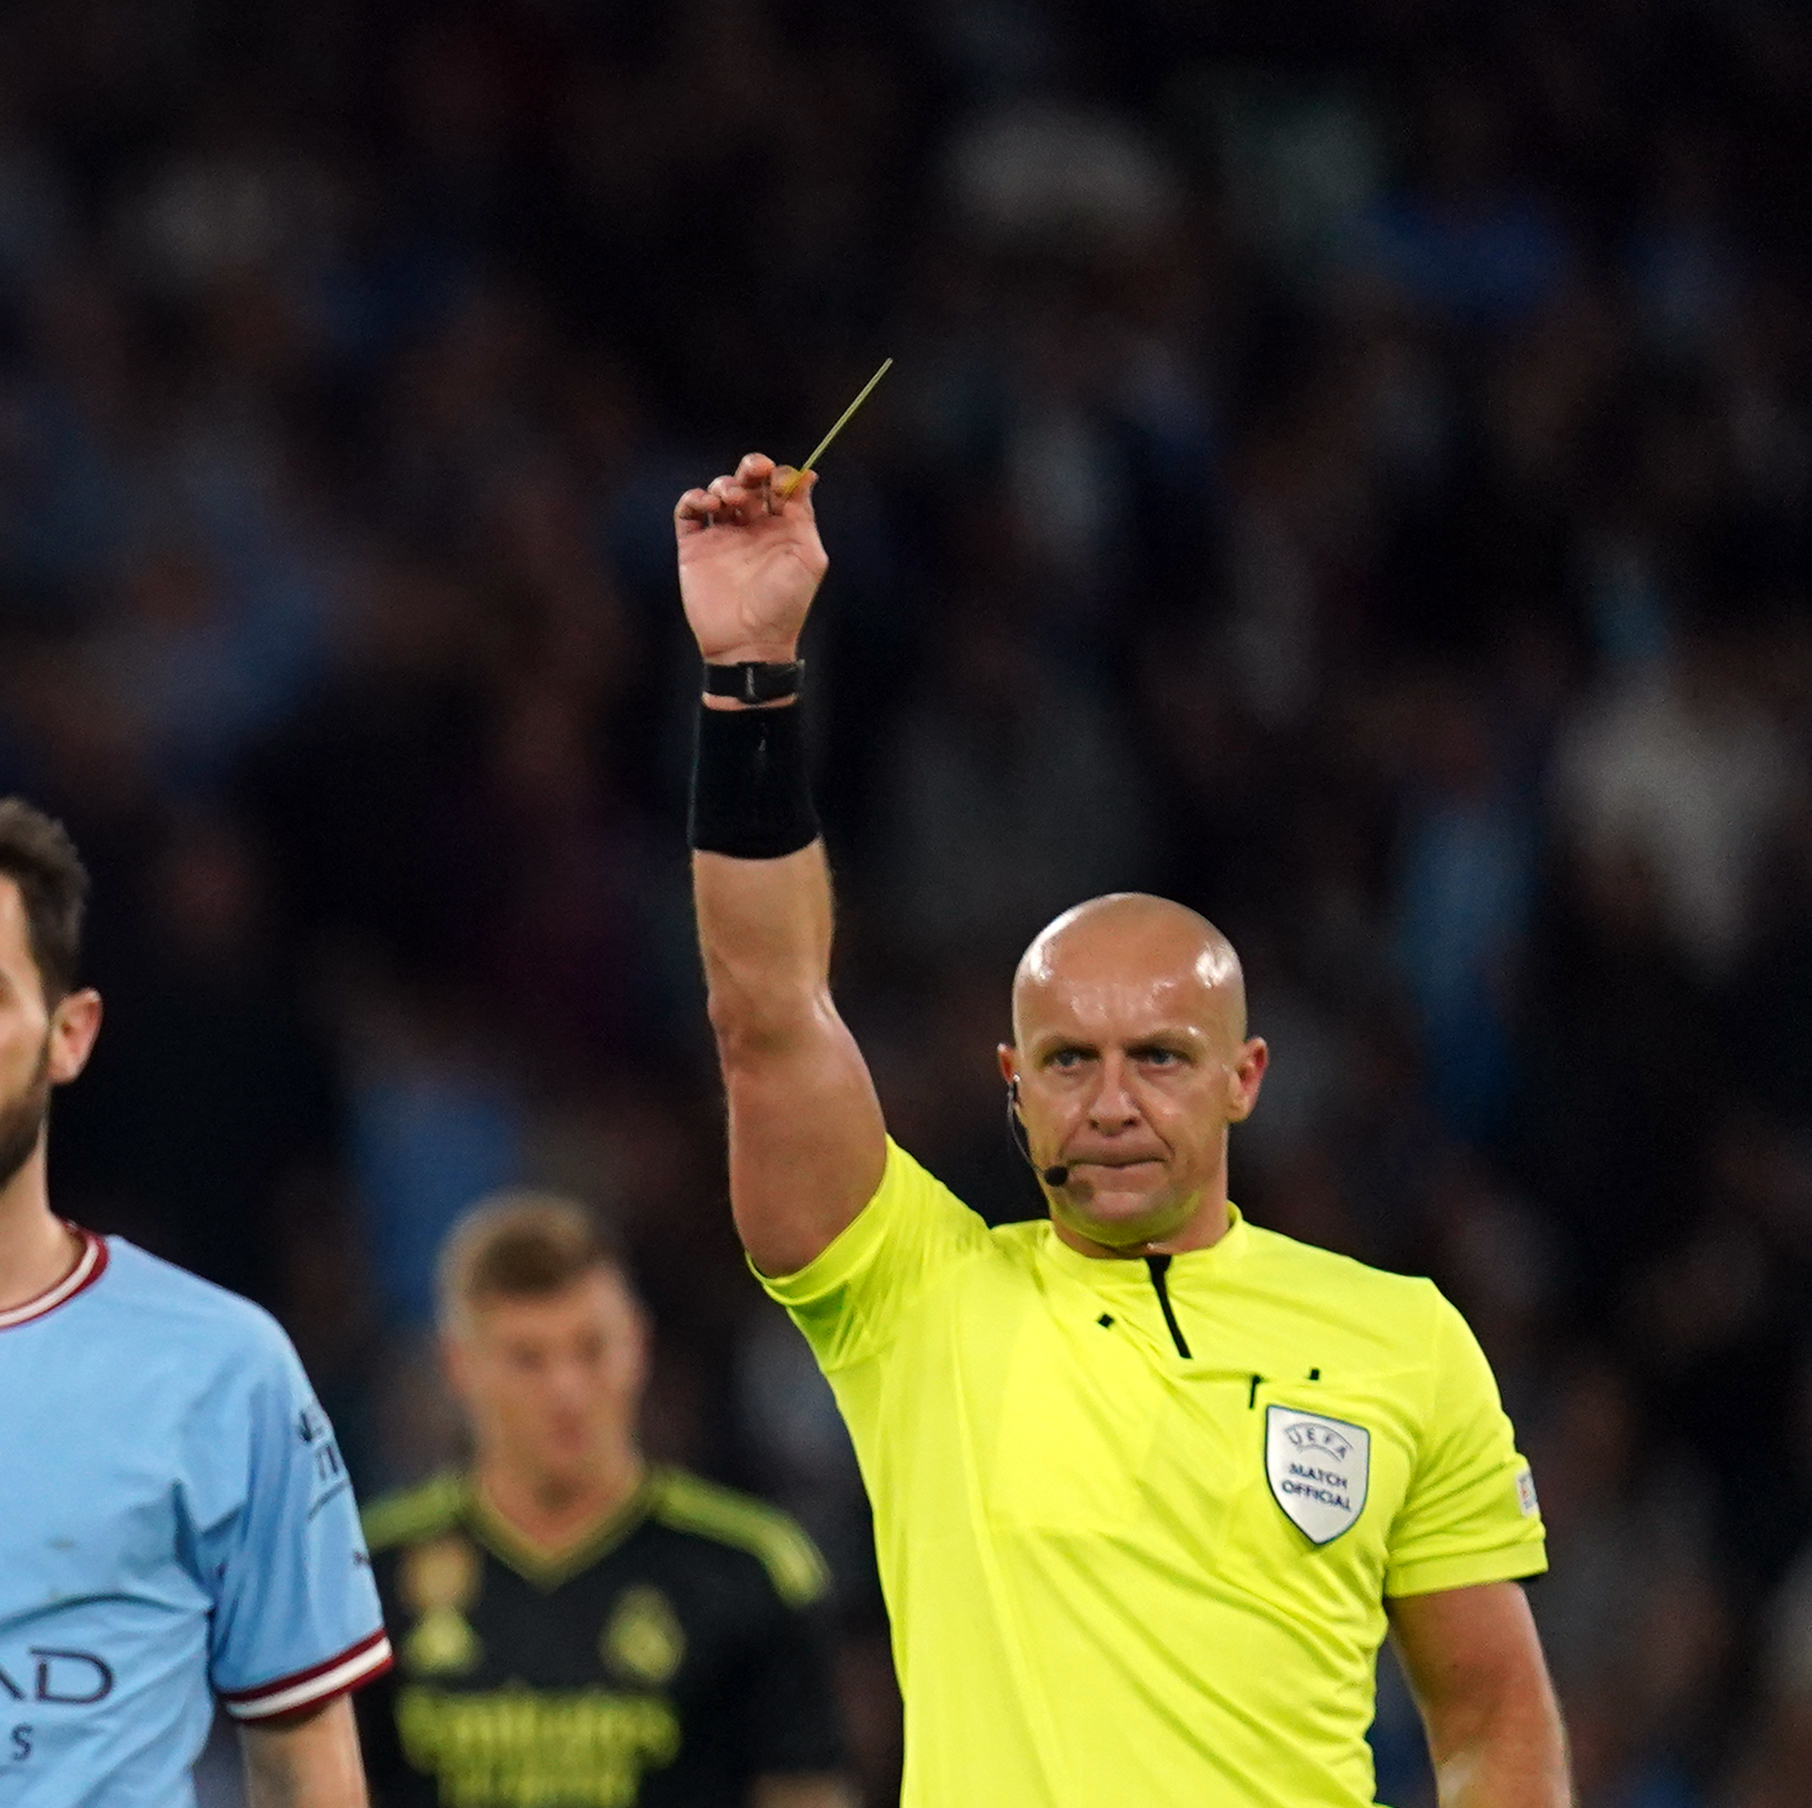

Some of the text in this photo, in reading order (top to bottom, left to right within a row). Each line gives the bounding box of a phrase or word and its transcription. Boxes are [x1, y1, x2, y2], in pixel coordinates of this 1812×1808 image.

[1285, 1426, 1347, 1460] UEFA
[1289, 1463, 1348, 1489] MATCH
[1281, 1480, 1352, 1513] OFFICIAL
